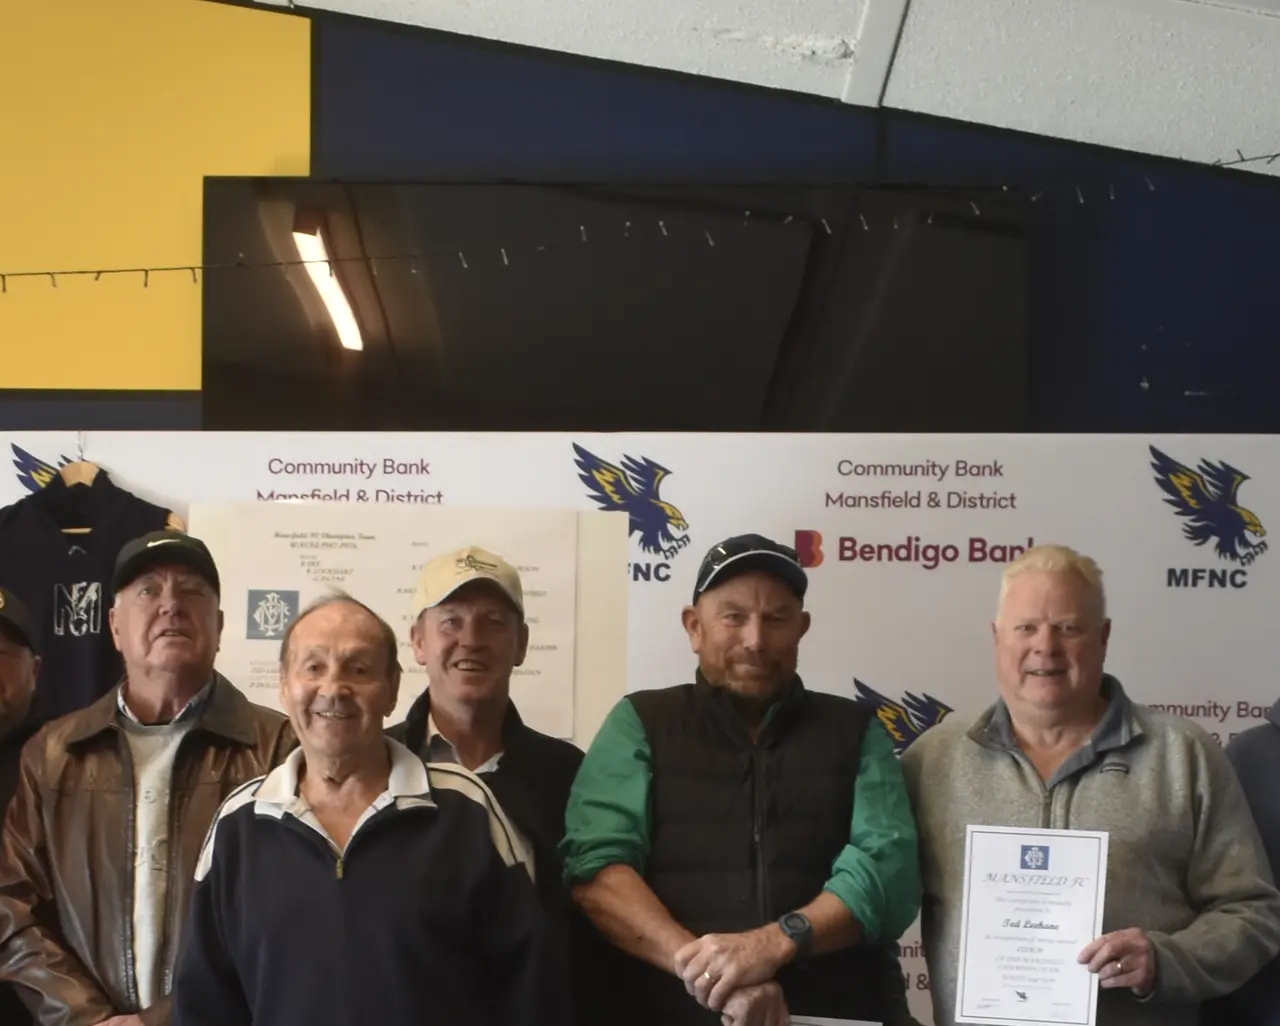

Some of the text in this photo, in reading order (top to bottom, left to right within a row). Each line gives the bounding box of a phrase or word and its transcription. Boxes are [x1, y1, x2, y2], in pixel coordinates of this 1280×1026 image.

[267, 458, 430, 479] Community Bank
[837, 459, 1004, 482] Community Bank
[376, 489, 444, 503] District
[825, 491, 1017, 509] Mansfield & District
[839, 536, 960, 570] Bendigo
[628, 562, 671, 582] NC
[1166, 568, 1248, 588] MFNC
